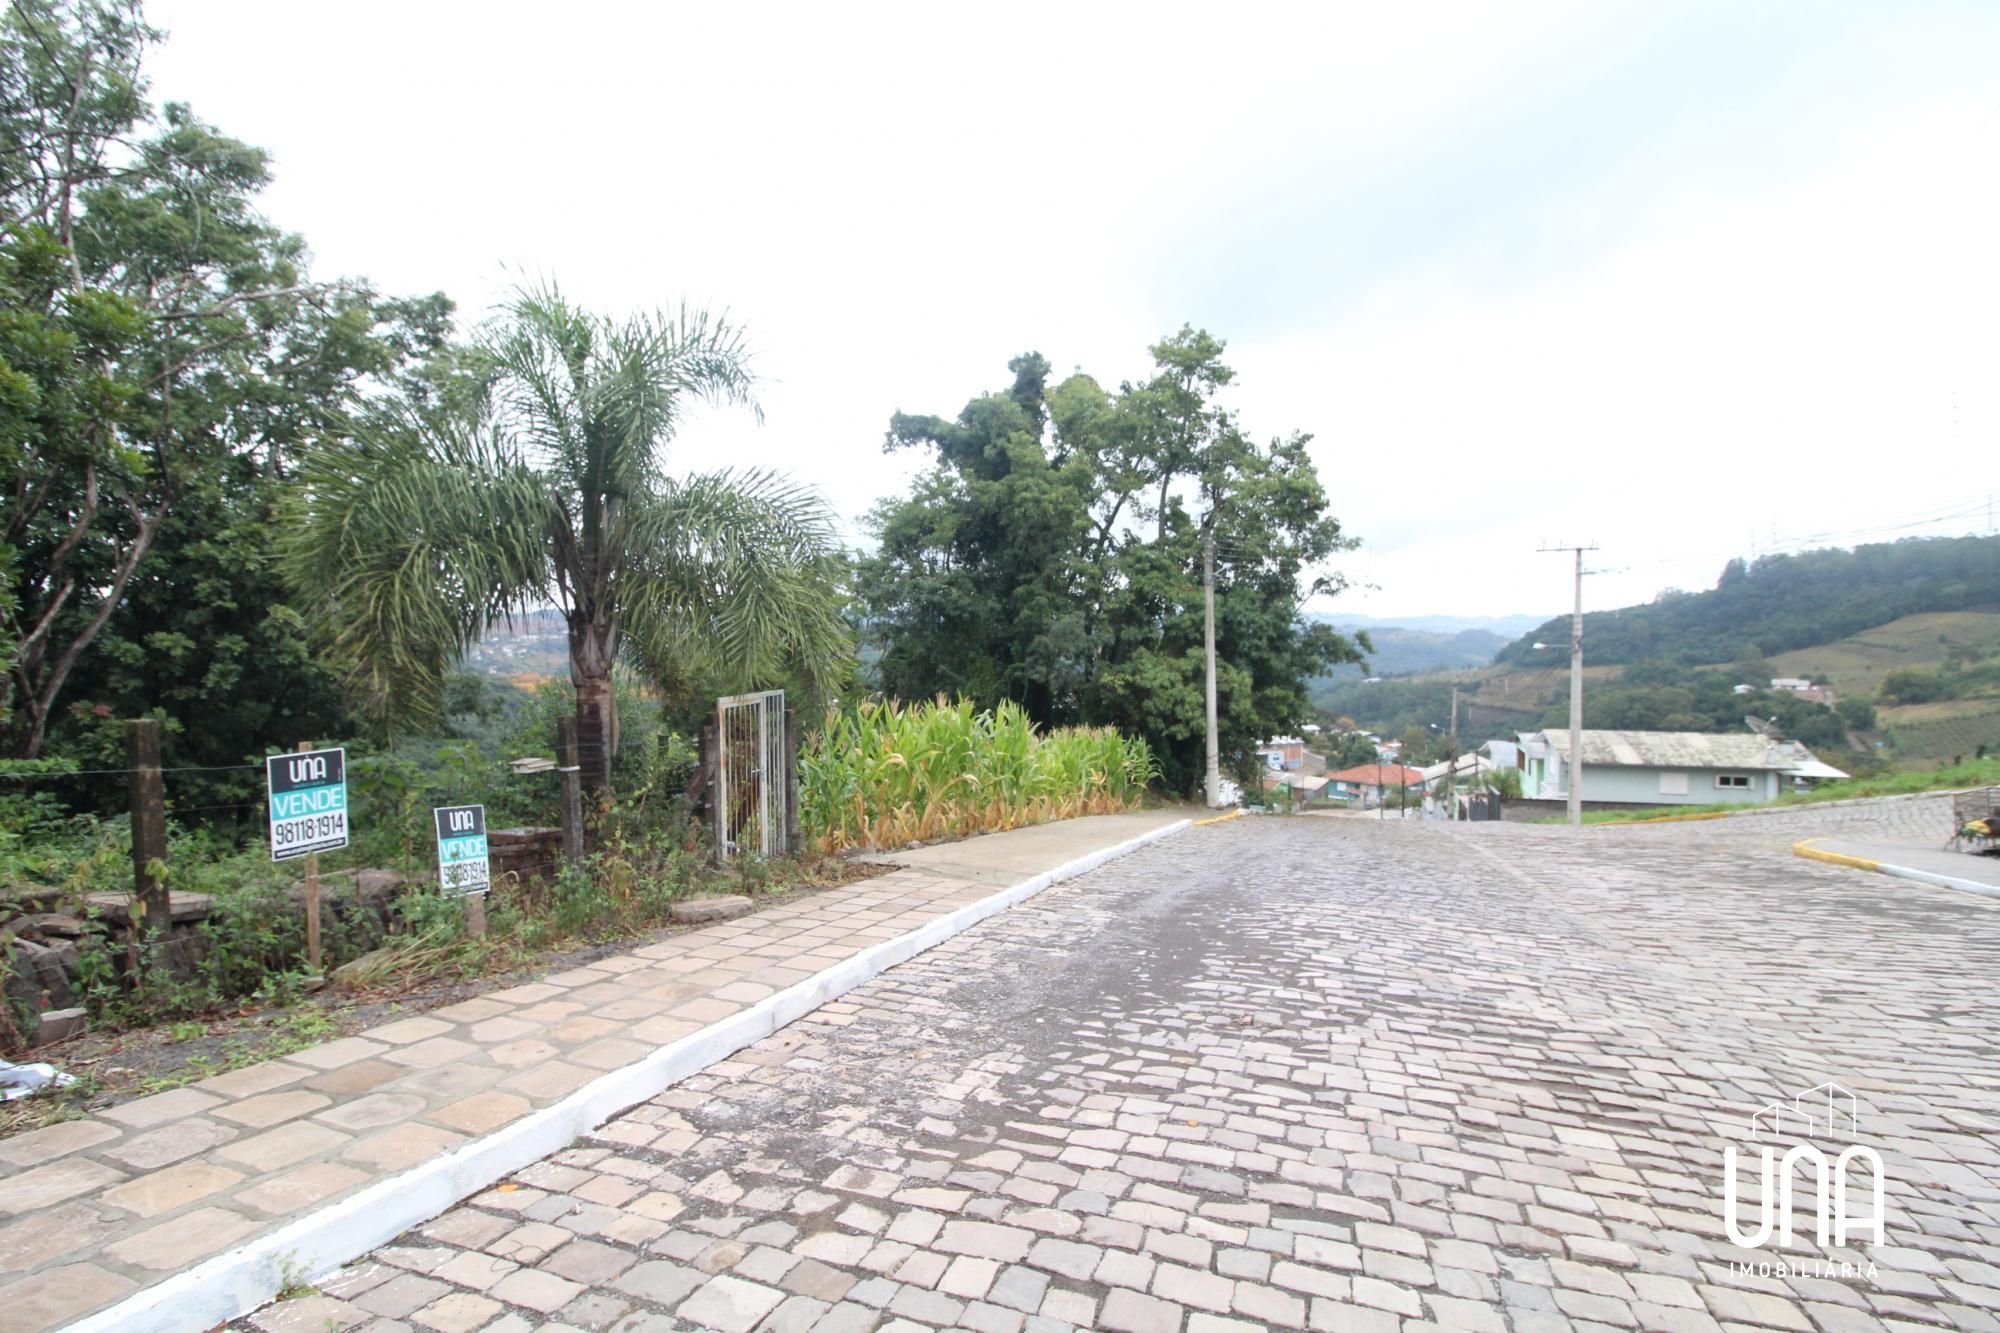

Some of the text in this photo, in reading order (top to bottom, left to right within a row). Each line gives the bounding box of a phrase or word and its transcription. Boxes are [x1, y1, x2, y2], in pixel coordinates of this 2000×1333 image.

[289, 757, 327, 783] UNA
[273, 787, 343, 817] VENDE
[449, 810, 475, 832] UNA
[441, 838, 486, 860] VENDE
